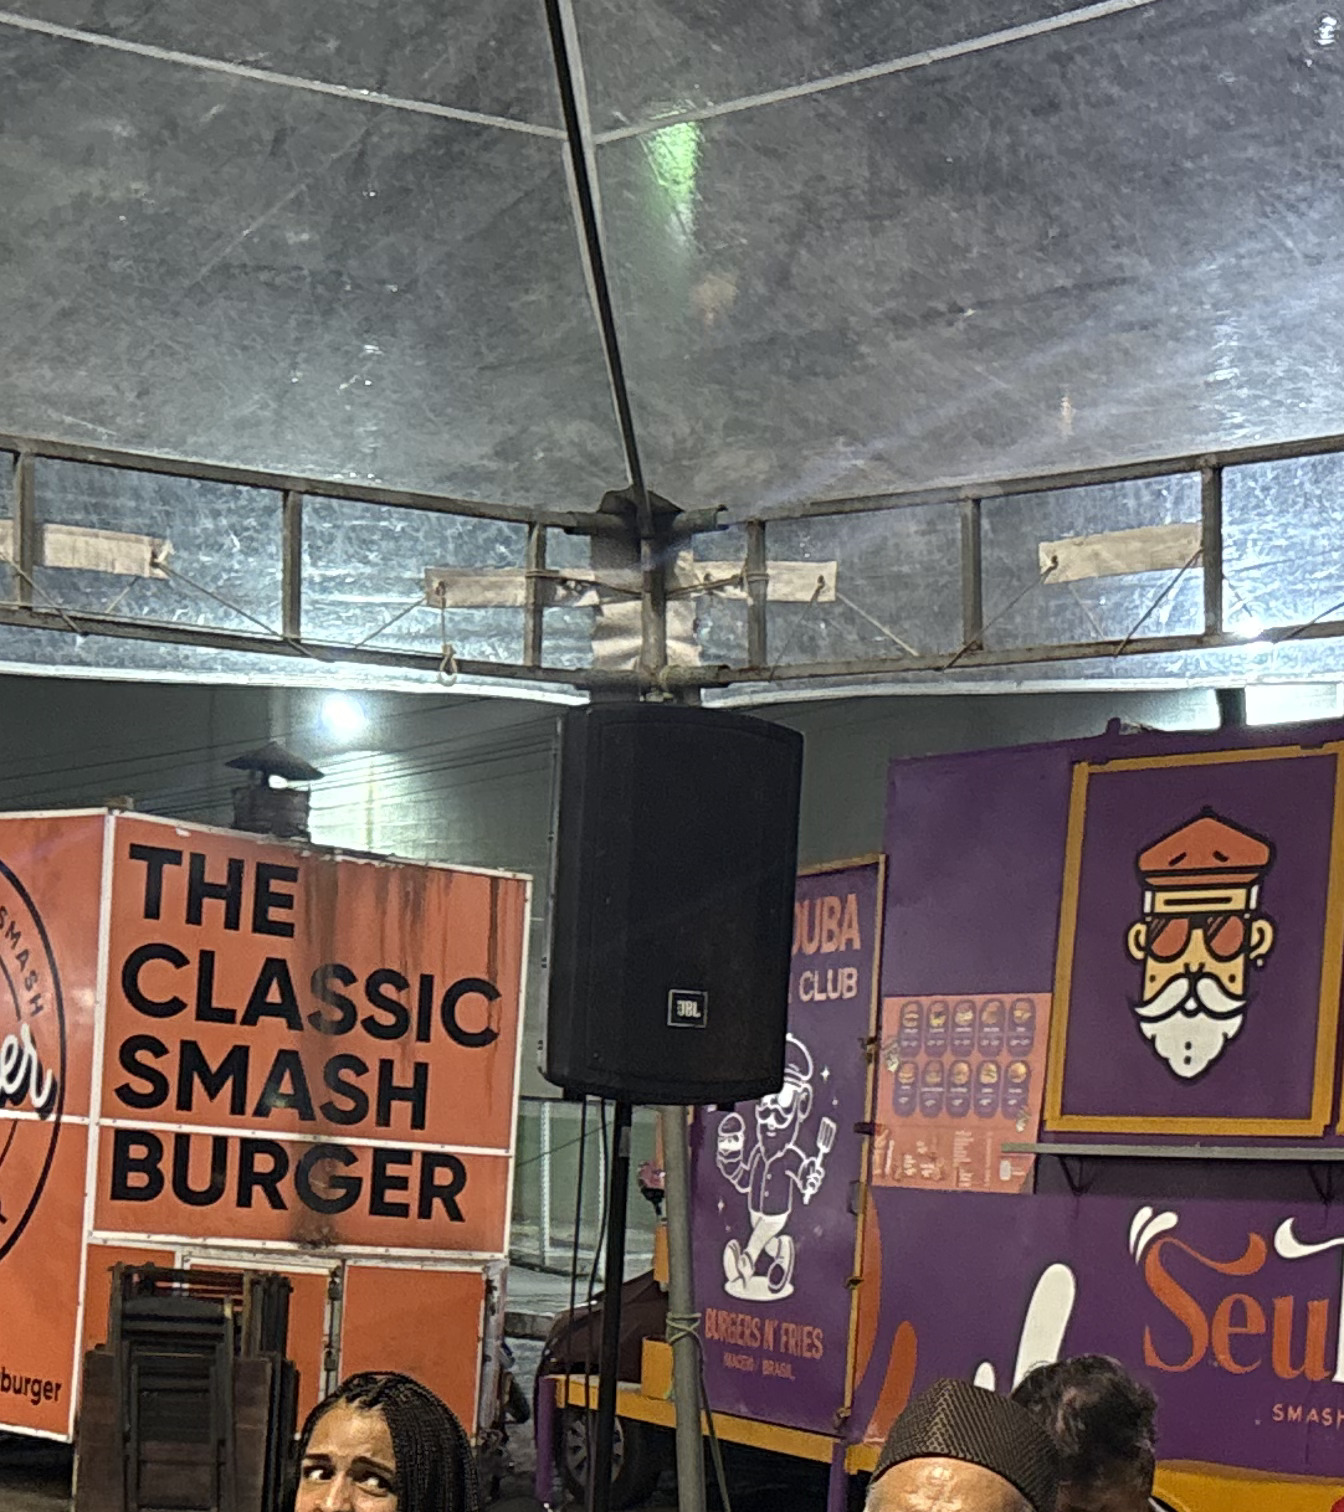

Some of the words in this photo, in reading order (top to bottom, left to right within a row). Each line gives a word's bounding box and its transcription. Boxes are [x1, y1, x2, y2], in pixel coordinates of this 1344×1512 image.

[129, 843, 300, 938] THE
[121, 942, 503, 1049] CLASSIC
[676, 1000, 702, 1018] JBL
[799, 966, 859, 1003] CLUB
[114, 1034, 429, 1131] SMASH
[109, 1129, 468, 1223] BURGER
[704, 1307, 761, 1348] BURGERS
[780, 1321, 824, 1360] FRIES
